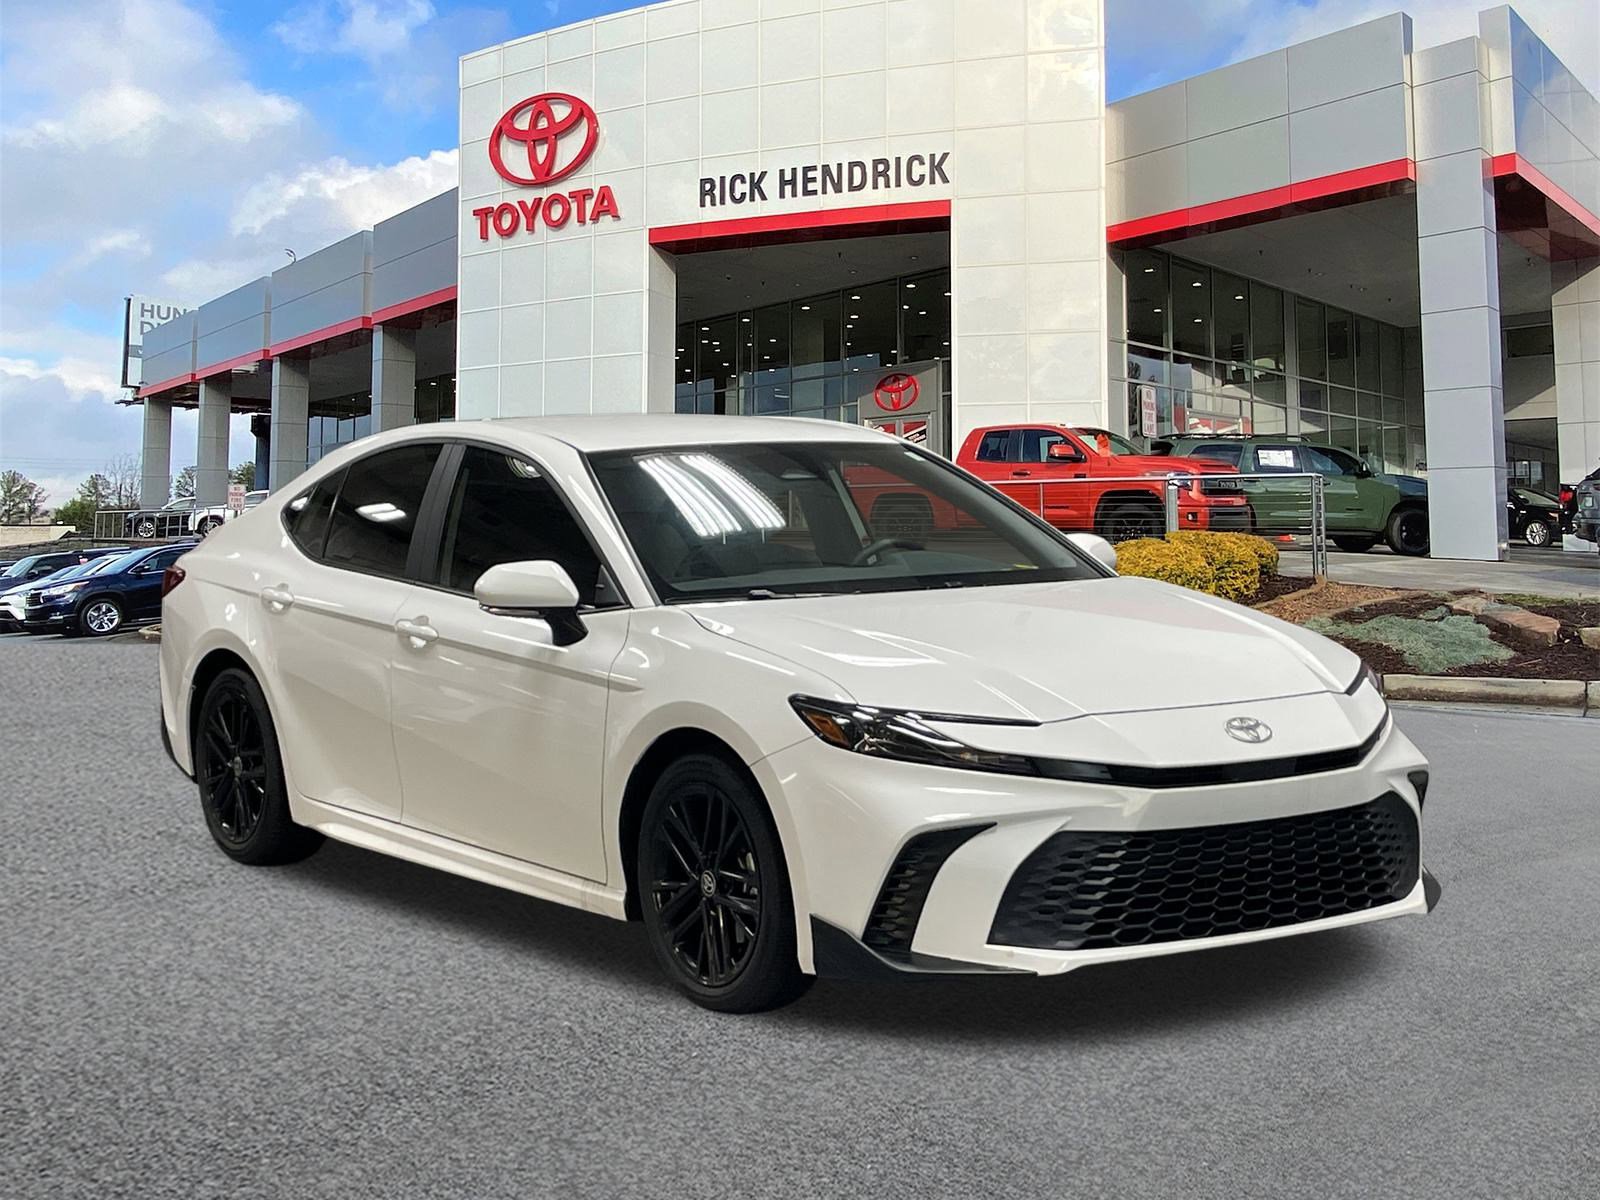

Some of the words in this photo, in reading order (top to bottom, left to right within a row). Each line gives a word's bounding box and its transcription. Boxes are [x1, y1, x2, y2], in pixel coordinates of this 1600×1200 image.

[699, 171, 768, 208] RICK
[778, 152, 950, 199] HENDRICK
[472, 185, 620, 241] TOYOTA
